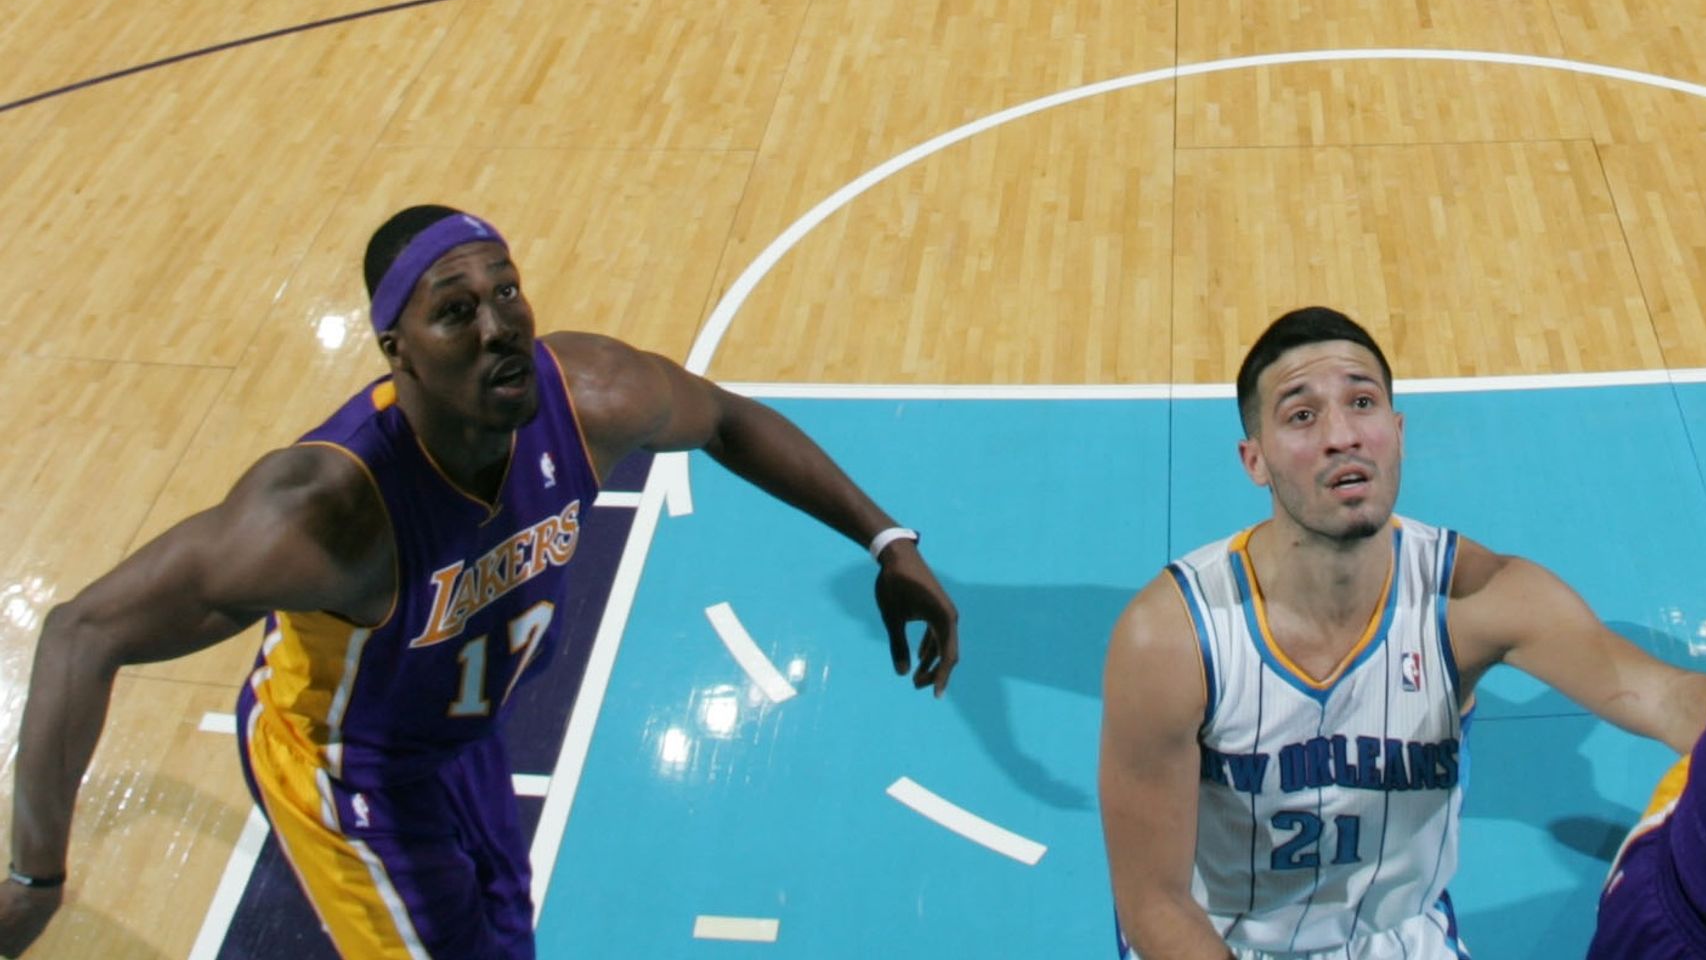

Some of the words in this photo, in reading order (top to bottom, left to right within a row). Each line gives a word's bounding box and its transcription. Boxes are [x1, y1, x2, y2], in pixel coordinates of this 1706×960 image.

[408, 499, 581, 649] LAKERS
[447, 599, 555, 718] 17
[1278, 734, 1460, 794] ORLEANS
[1270, 810, 1363, 870] 21
